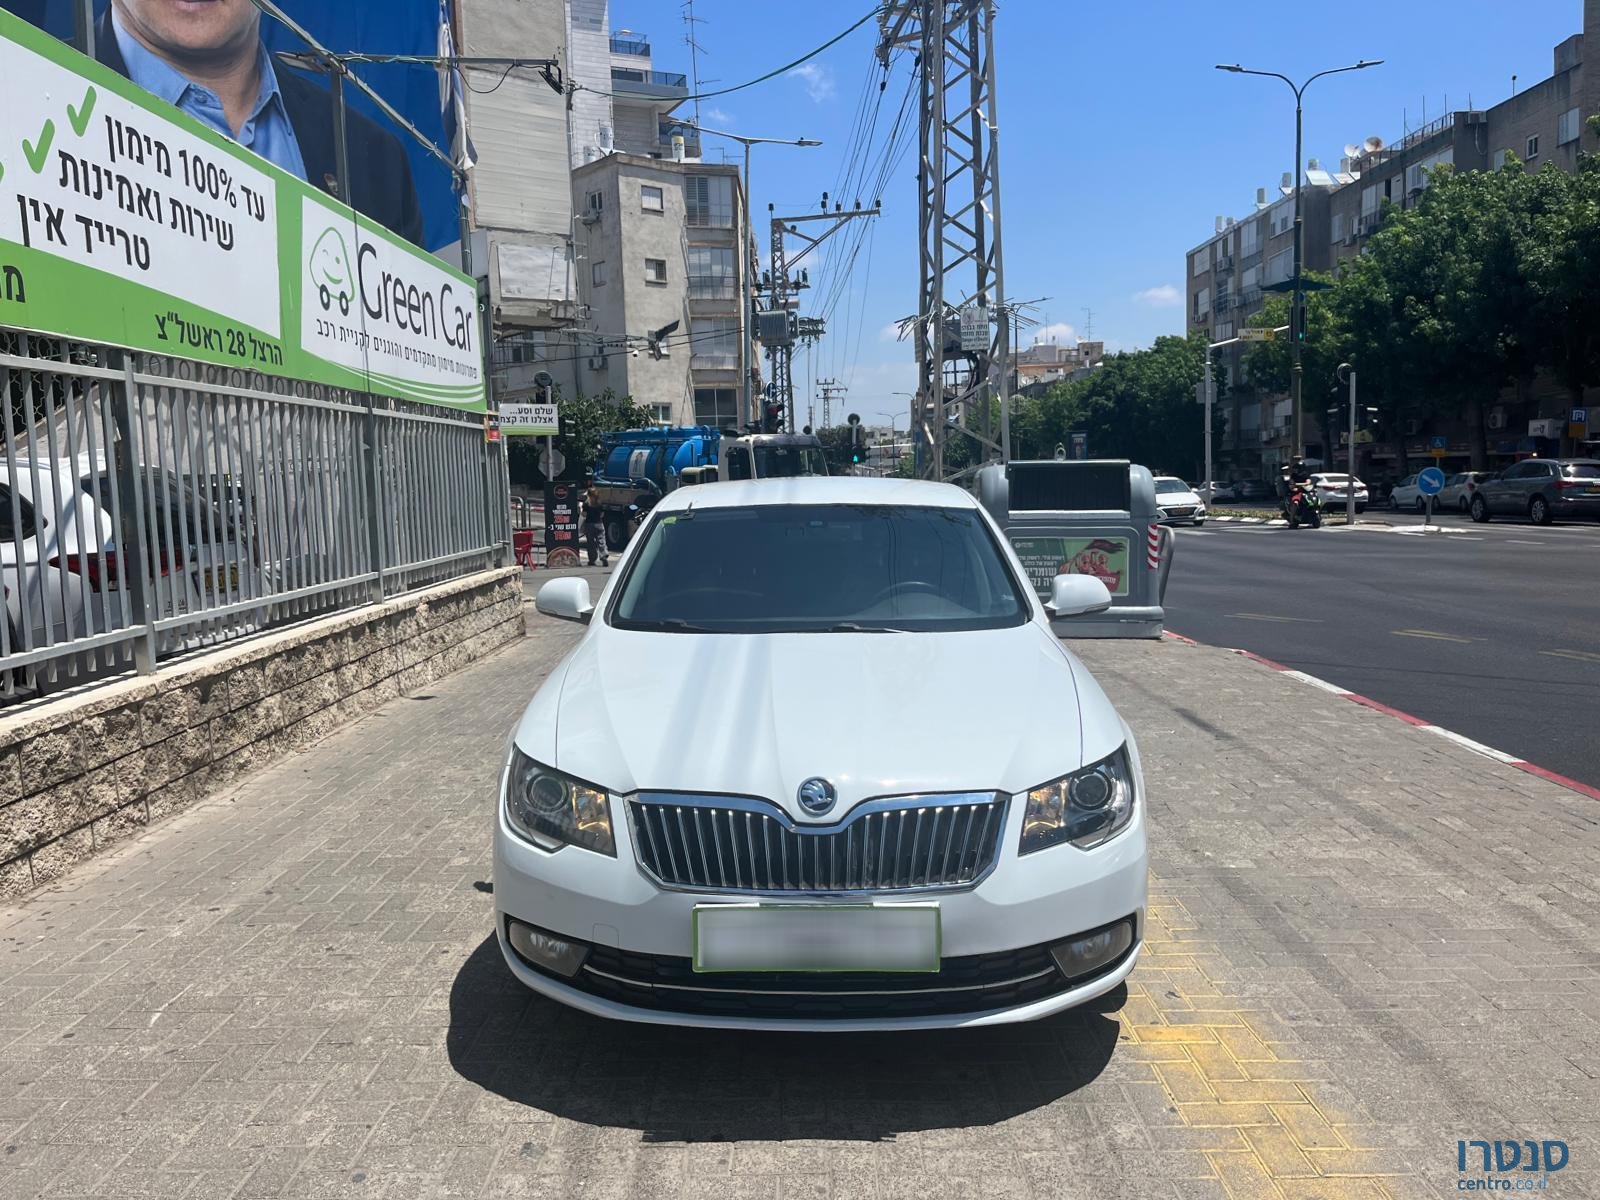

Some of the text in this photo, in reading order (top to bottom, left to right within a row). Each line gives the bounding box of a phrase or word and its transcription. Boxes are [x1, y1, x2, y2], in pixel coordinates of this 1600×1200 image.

[105, 114, 266, 222] עד 100% מימון
[58, 149, 234, 251] שירות ואמינות
[17, 194, 150, 271] טרייד אין
[358, 242, 472, 352] Green Car
[316, 318, 336, 339] רכב
[340, 326, 369, 351] לקניית
[226, 328, 246, 357] 28
[249, 332, 283, 366] הרצל
[373, 336, 402, 358] והוגנים
[404, 346, 436, 368] מתקדמים
[531, 415, 553, 423] אצלנו
[535, 406, 553, 415] שלם
